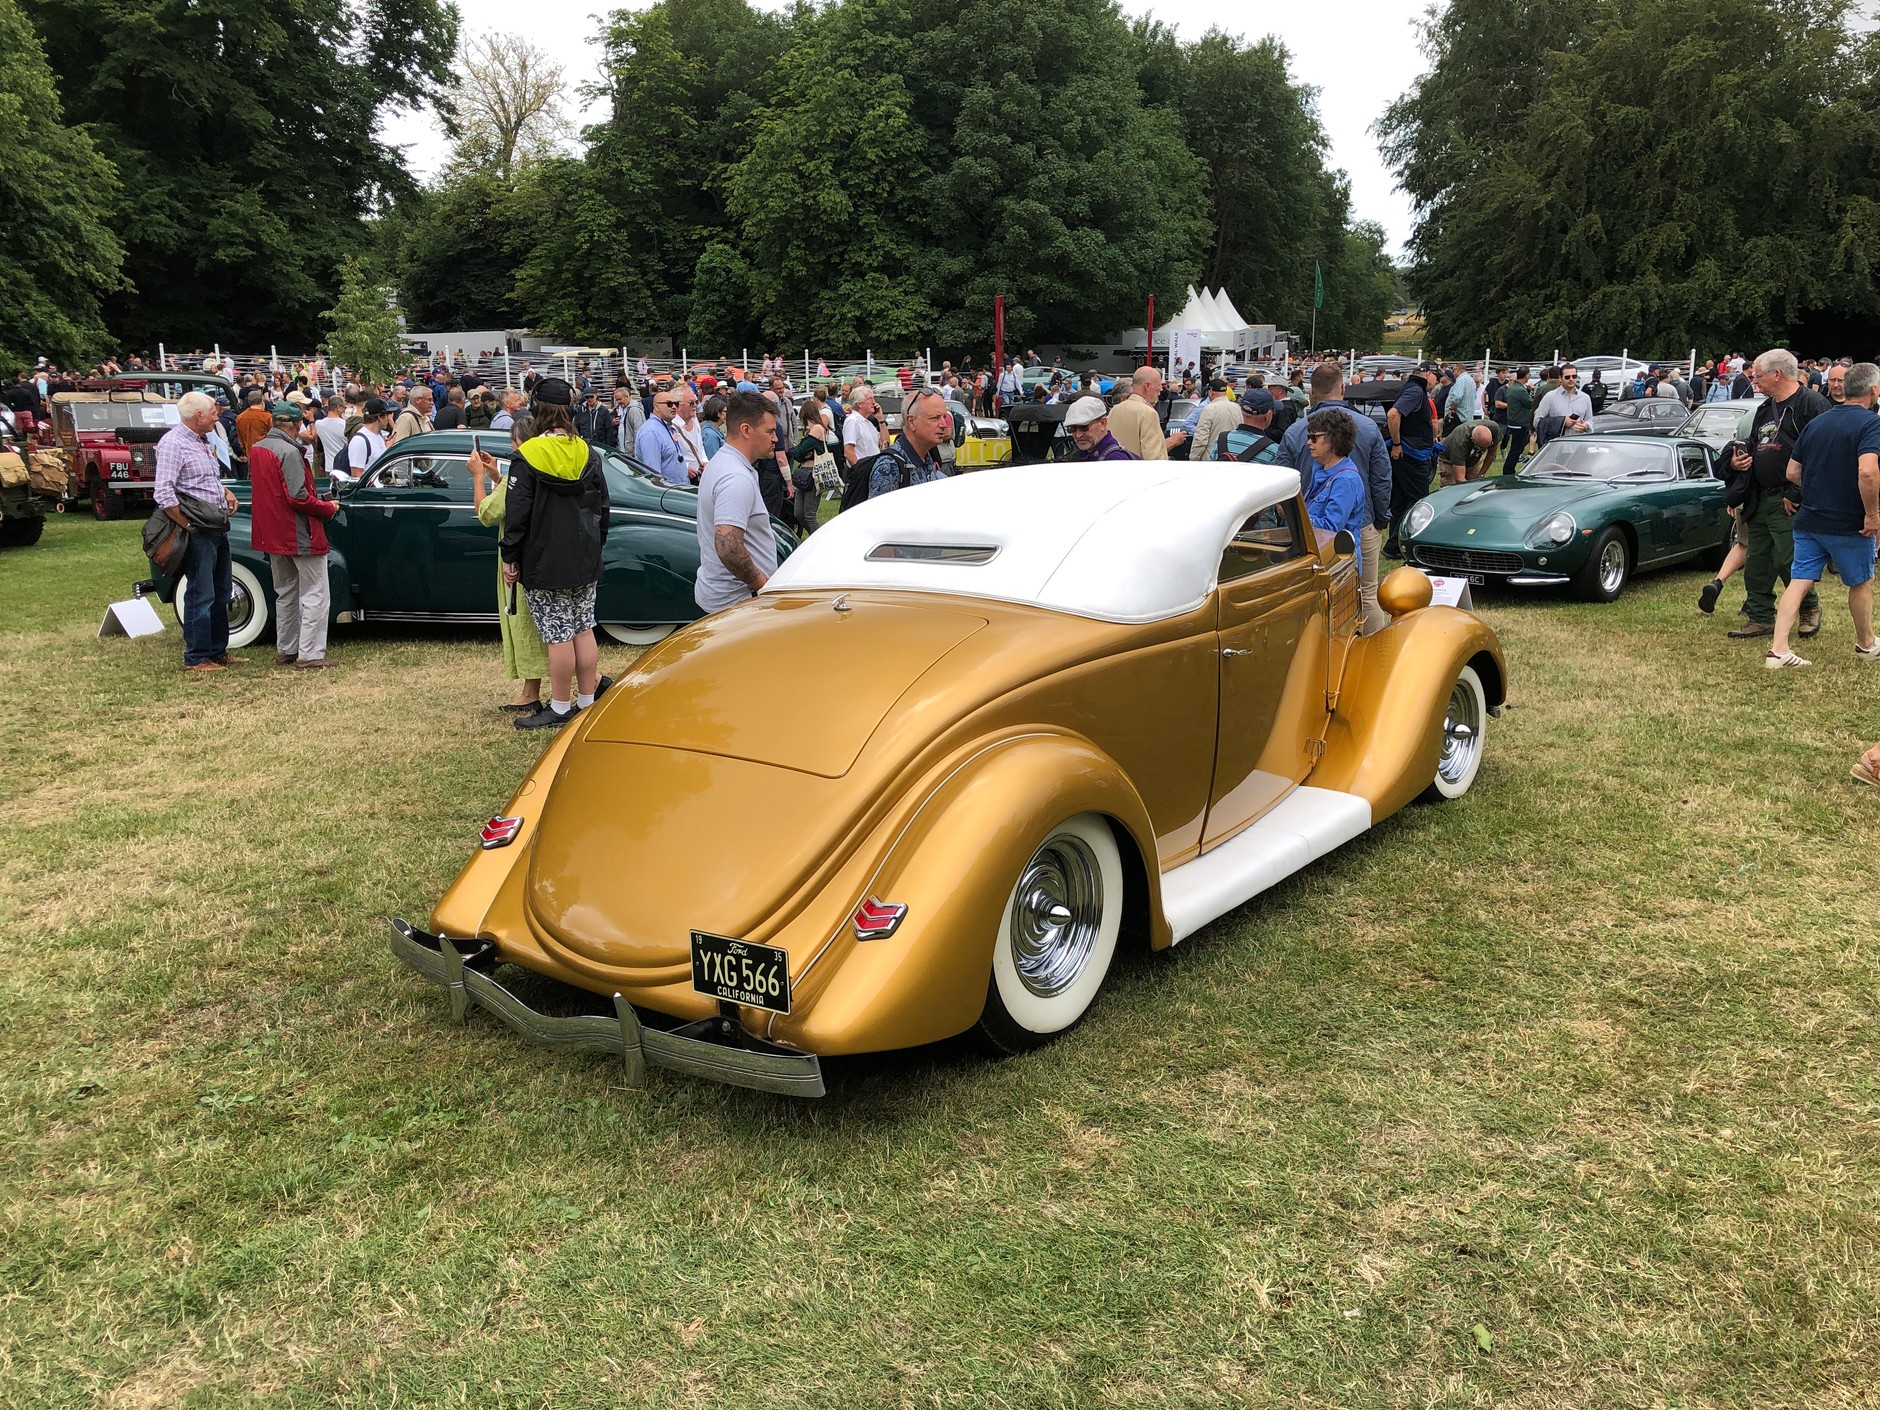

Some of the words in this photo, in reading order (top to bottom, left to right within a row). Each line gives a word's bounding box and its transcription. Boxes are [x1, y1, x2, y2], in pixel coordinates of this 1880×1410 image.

[110, 463, 129, 471] FBU
[695, 934, 702, 945] 19
[773, 951, 782, 962] 35
[727, 942, 748, 956] Ford
[699, 949, 737, 987] YXG
[742, 958, 780, 997] 566
[717, 985, 764, 1005] CALIFORNIA
